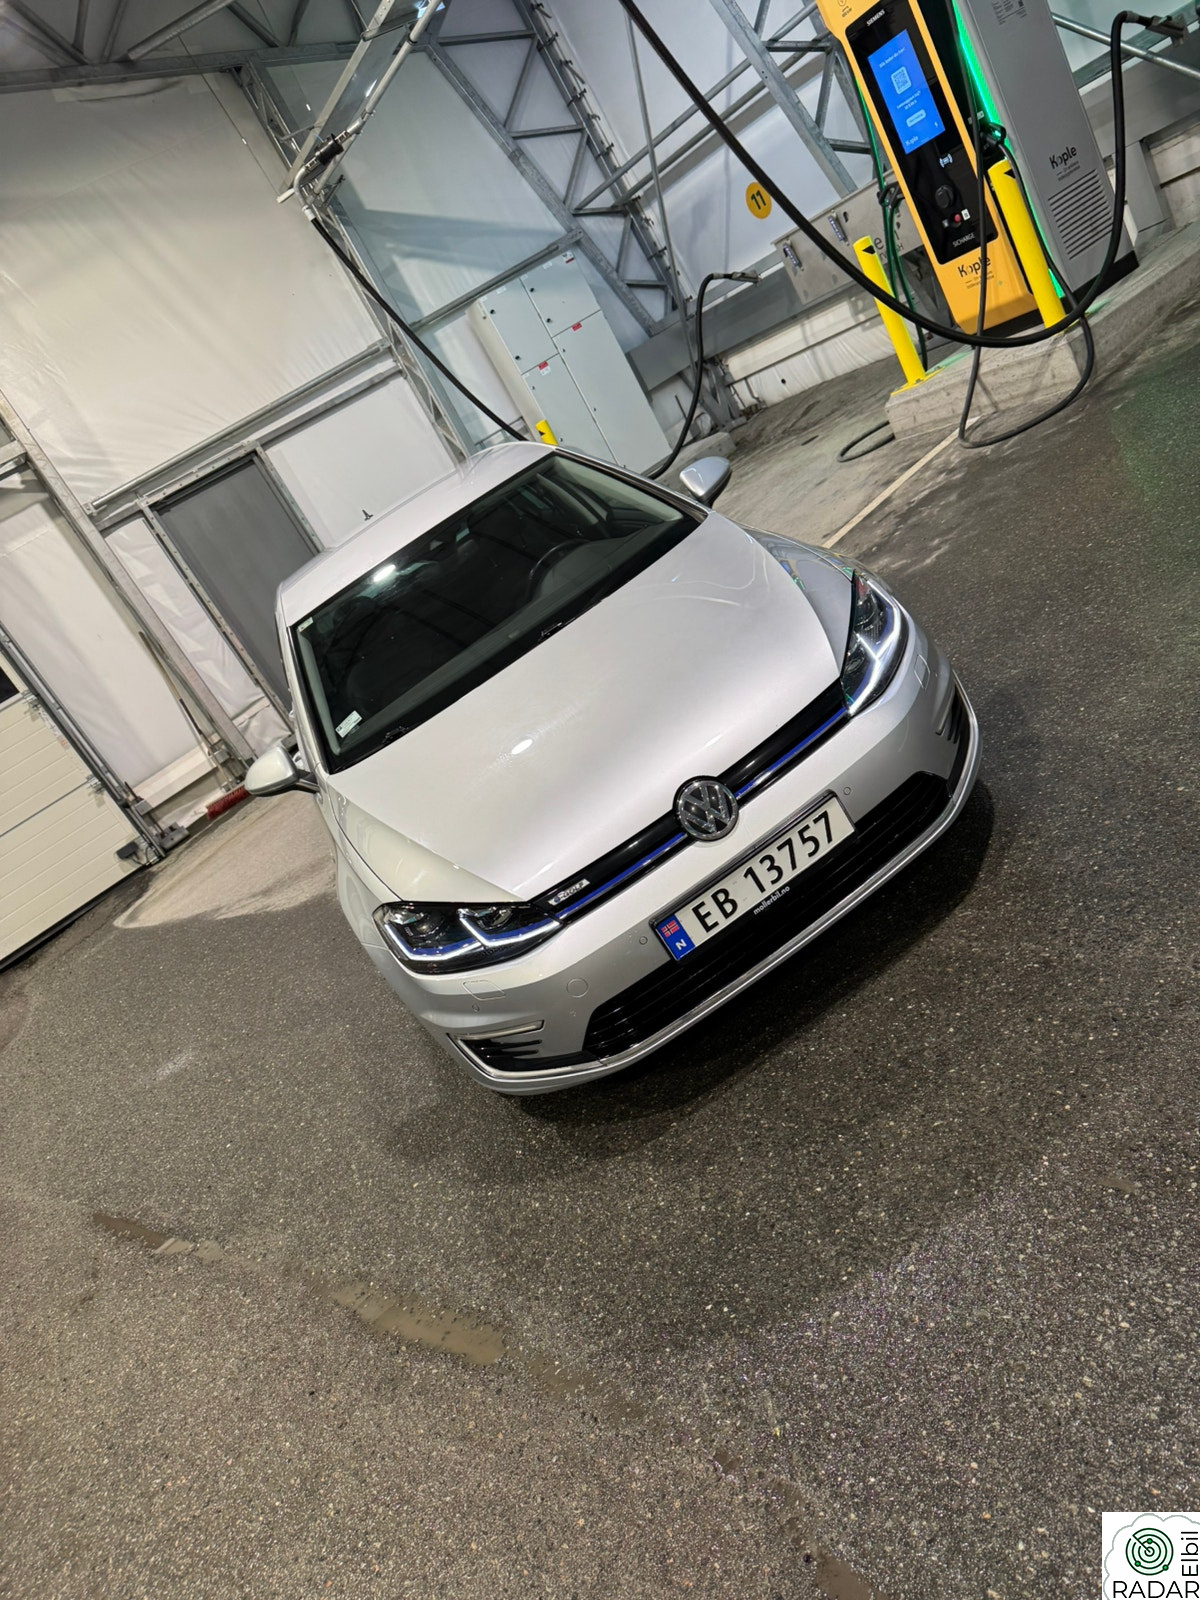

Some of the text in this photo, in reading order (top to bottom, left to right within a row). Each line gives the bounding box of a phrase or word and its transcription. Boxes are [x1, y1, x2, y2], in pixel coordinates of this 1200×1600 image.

[866, 9, 886, 26] SIEMENS
[1049, 146, 1077, 169] Kople
[750, 189, 767, 210] 11
[952, 232, 975, 247] SICHARGE
[691, 810, 833, 933] EB 13757
[675, 939, 687, 950] N
